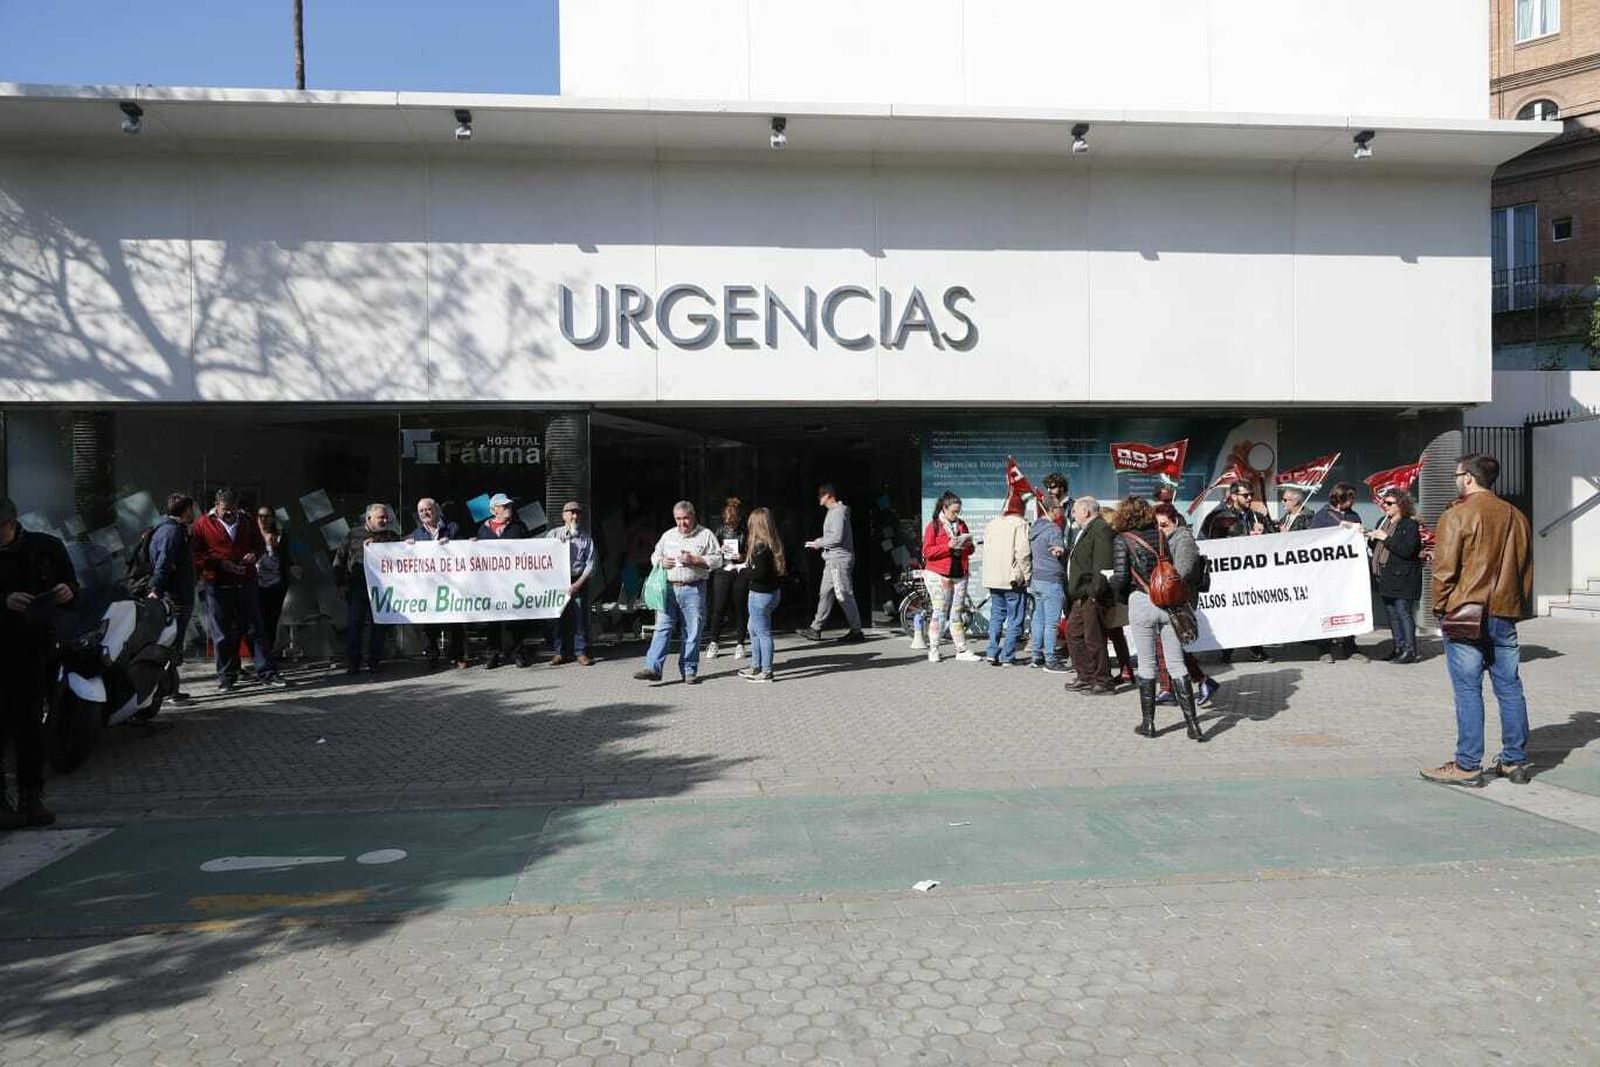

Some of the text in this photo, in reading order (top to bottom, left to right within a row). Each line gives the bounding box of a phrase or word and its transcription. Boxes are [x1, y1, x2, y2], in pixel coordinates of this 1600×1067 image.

[558, 284, 979, 351] URGENCIAS
[487, 435, 541, 446] HOSPITAL
[445, 440, 541, 464] Fátima
[932, 460, 978, 469] Urgencias
[381, 552, 553, 573] EN DEFENSA DE LA SANIDAD PÚBLICA
[1274, 544, 1359, 566] LABORAL
[371, 582, 566, 613] Marea Blanca en Sevilla
[1232, 587, 1292, 607] AUTÓNOMOS,
[1293, 586, 1309, 600] YA!
